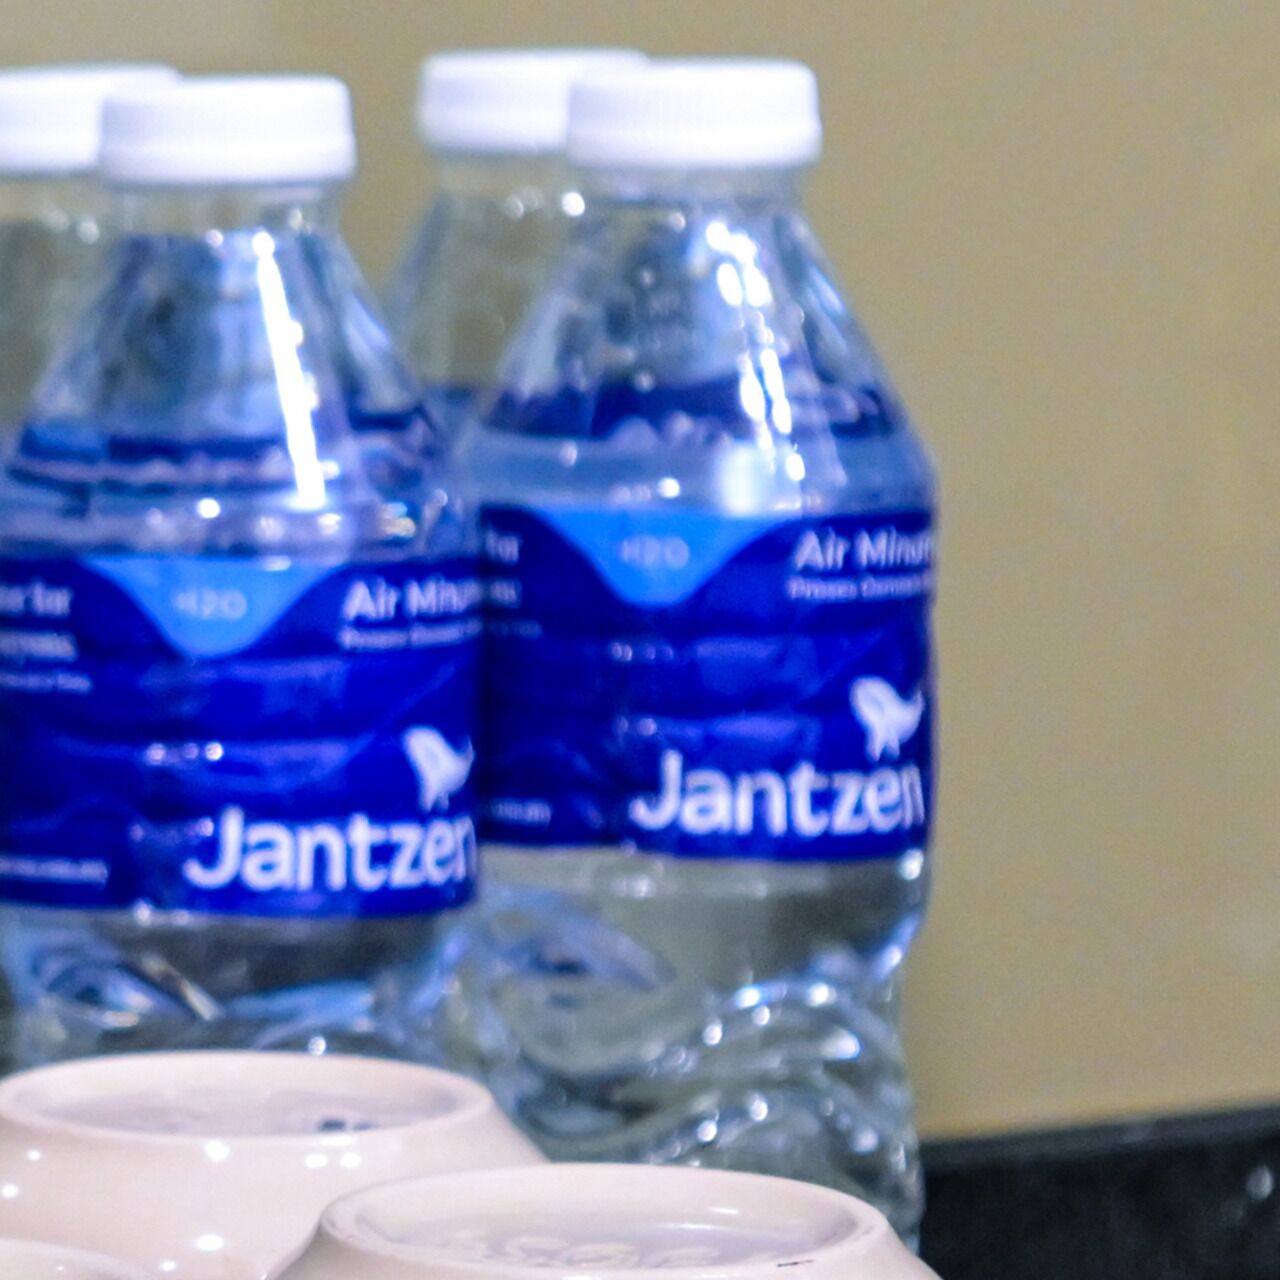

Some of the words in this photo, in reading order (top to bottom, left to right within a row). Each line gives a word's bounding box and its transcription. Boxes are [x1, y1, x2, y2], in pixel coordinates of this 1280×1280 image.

[794, 531, 850, 569] Air
[342, 579, 398, 621] Air
[629, 750, 924, 835] Jantzen
[183, 806, 475, 890] Jantzen
